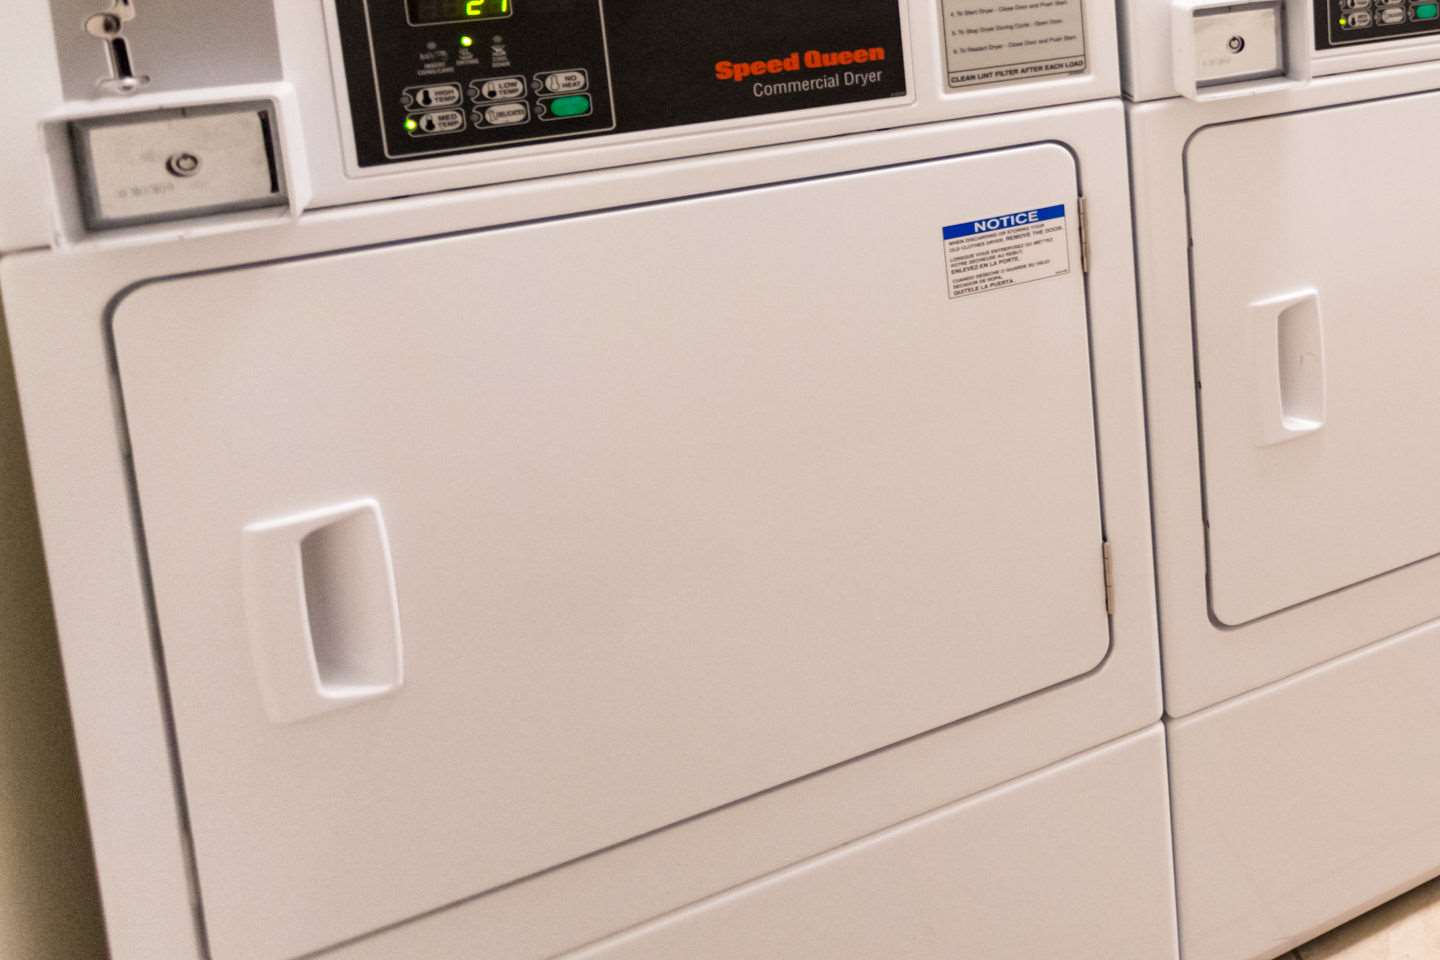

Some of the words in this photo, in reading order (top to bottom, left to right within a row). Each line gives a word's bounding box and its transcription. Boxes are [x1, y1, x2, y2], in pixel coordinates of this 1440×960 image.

[714, 51, 800, 81] Speed
[804, 47, 886, 69] Queen
[951, 74, 977, 84] CLEAN
[977, 71, 993, 80] LINT
[995, 68, 1019, 78] FILTER
[1020, 65, 1043, 74] AFTER
[1044, 62, 1064, 71] EACH
[1064, 59, 1084, 68] LOAD
[498, 81, 518, 89] LOW
[562, 80, 581, 89] HEAT
[753, 74, 840, 98] Commercial
[844, 70, 884, 87] Dryer
[974, 211, 1039, 233] NOTICE
